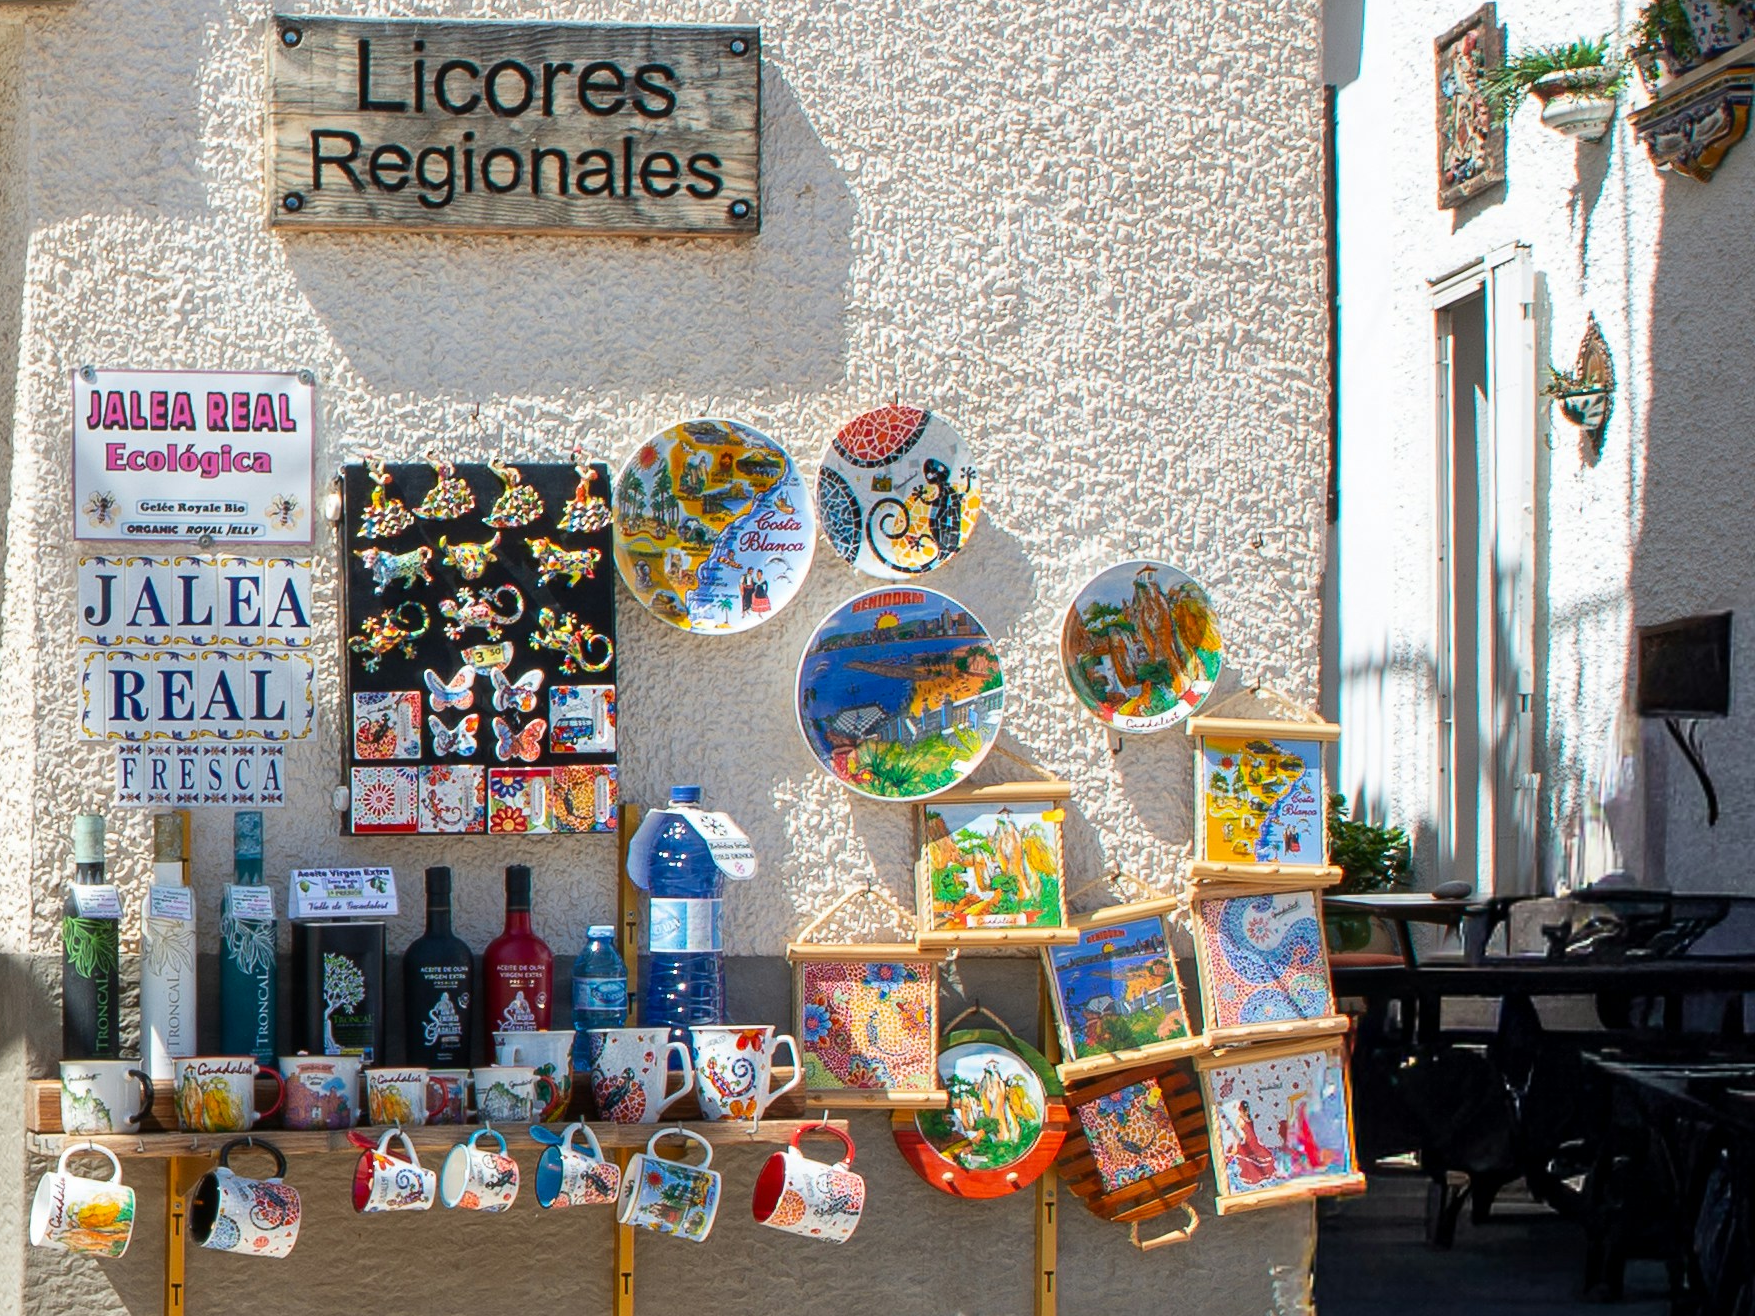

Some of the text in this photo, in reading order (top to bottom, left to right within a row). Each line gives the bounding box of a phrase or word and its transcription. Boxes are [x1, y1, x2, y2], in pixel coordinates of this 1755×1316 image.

[357, 38, 678, 120] Licores
[310, 128, 725, 210] Regionales
[86, 389, 297, 433] JALEA REAL
[105, 442, 272, 479] Ecológica
[126, 523, 179, 535] ORGANIC
[185, 524, 224, 536] ROYAL
[177, 501, 223, 515] Royale
[224, 502, 246, 514] Bio
[755, 510, 802, 531] Costa
[739, 530, 806, 552] Blanca
[83, 574, 311, 628] JALEA
[851, 591, 927, 614] BENIDORM
[108, 669, 286, 722] REAL
[121, 757, 281, 791] FRESCA
[96, 973, 109, 1052] TRONCAL
[167, 973, 181, 1050] TRONCAL
[256, 968, 270, 1048] TRONCAL
